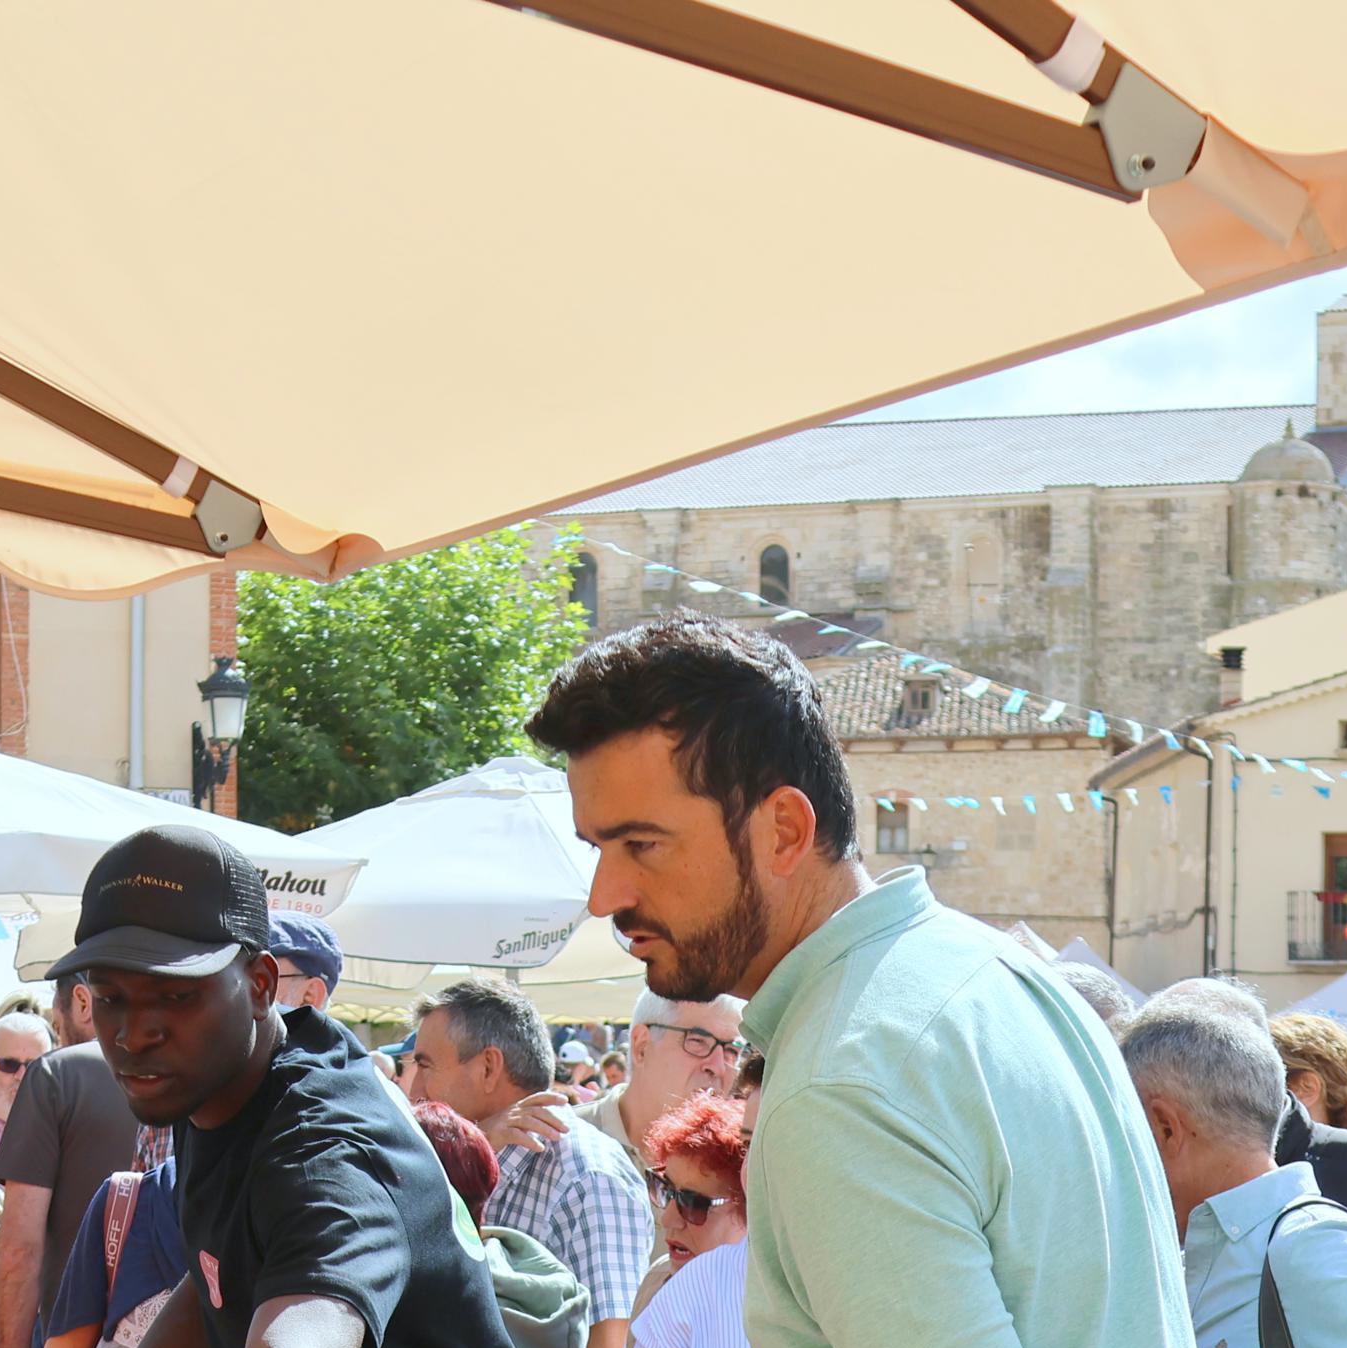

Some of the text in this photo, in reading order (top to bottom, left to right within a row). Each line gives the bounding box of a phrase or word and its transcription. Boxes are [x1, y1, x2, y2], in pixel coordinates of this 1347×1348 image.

[142, 875, 184, 892] WALKER
[287, 900, 323, 914] 1890
[106, 1218, 122, 1267] HOFF
